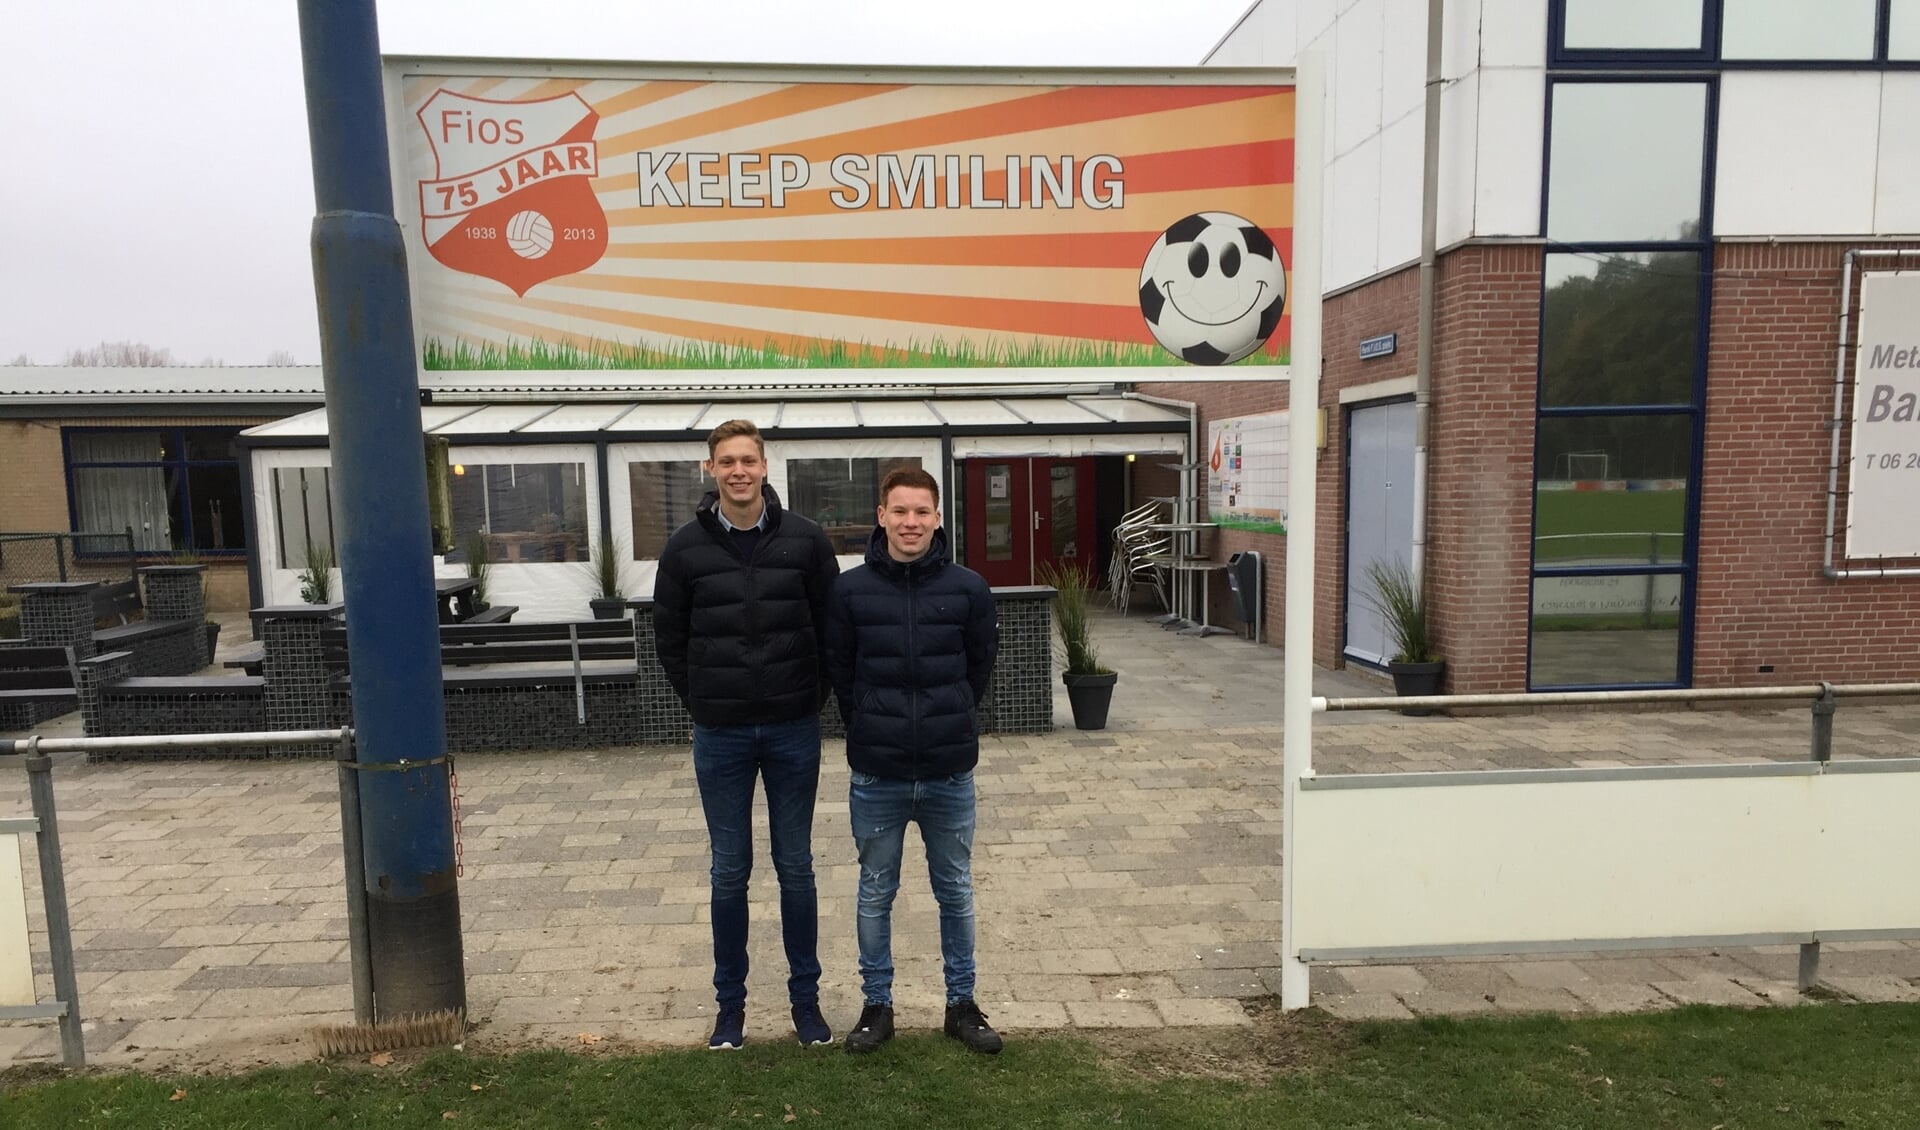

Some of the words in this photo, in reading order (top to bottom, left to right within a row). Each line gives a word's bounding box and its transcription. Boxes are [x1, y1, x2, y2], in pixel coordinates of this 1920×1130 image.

[441, 110, 524, 145] Fios
[436, 181, 479, 210] 75
[496, 145, 591, 194] JAAR
[637, 152, 811, 208] KEEP
[829, 153, 1125, 209] SMILING
[465, 227, 497, 240] 1938
[563, 228, 596, 241] 2013
[1866, 384, 1920, 422] Ba
[1866, 454, 1876, 469] T
[1879, 453, 1901, 469] 06
